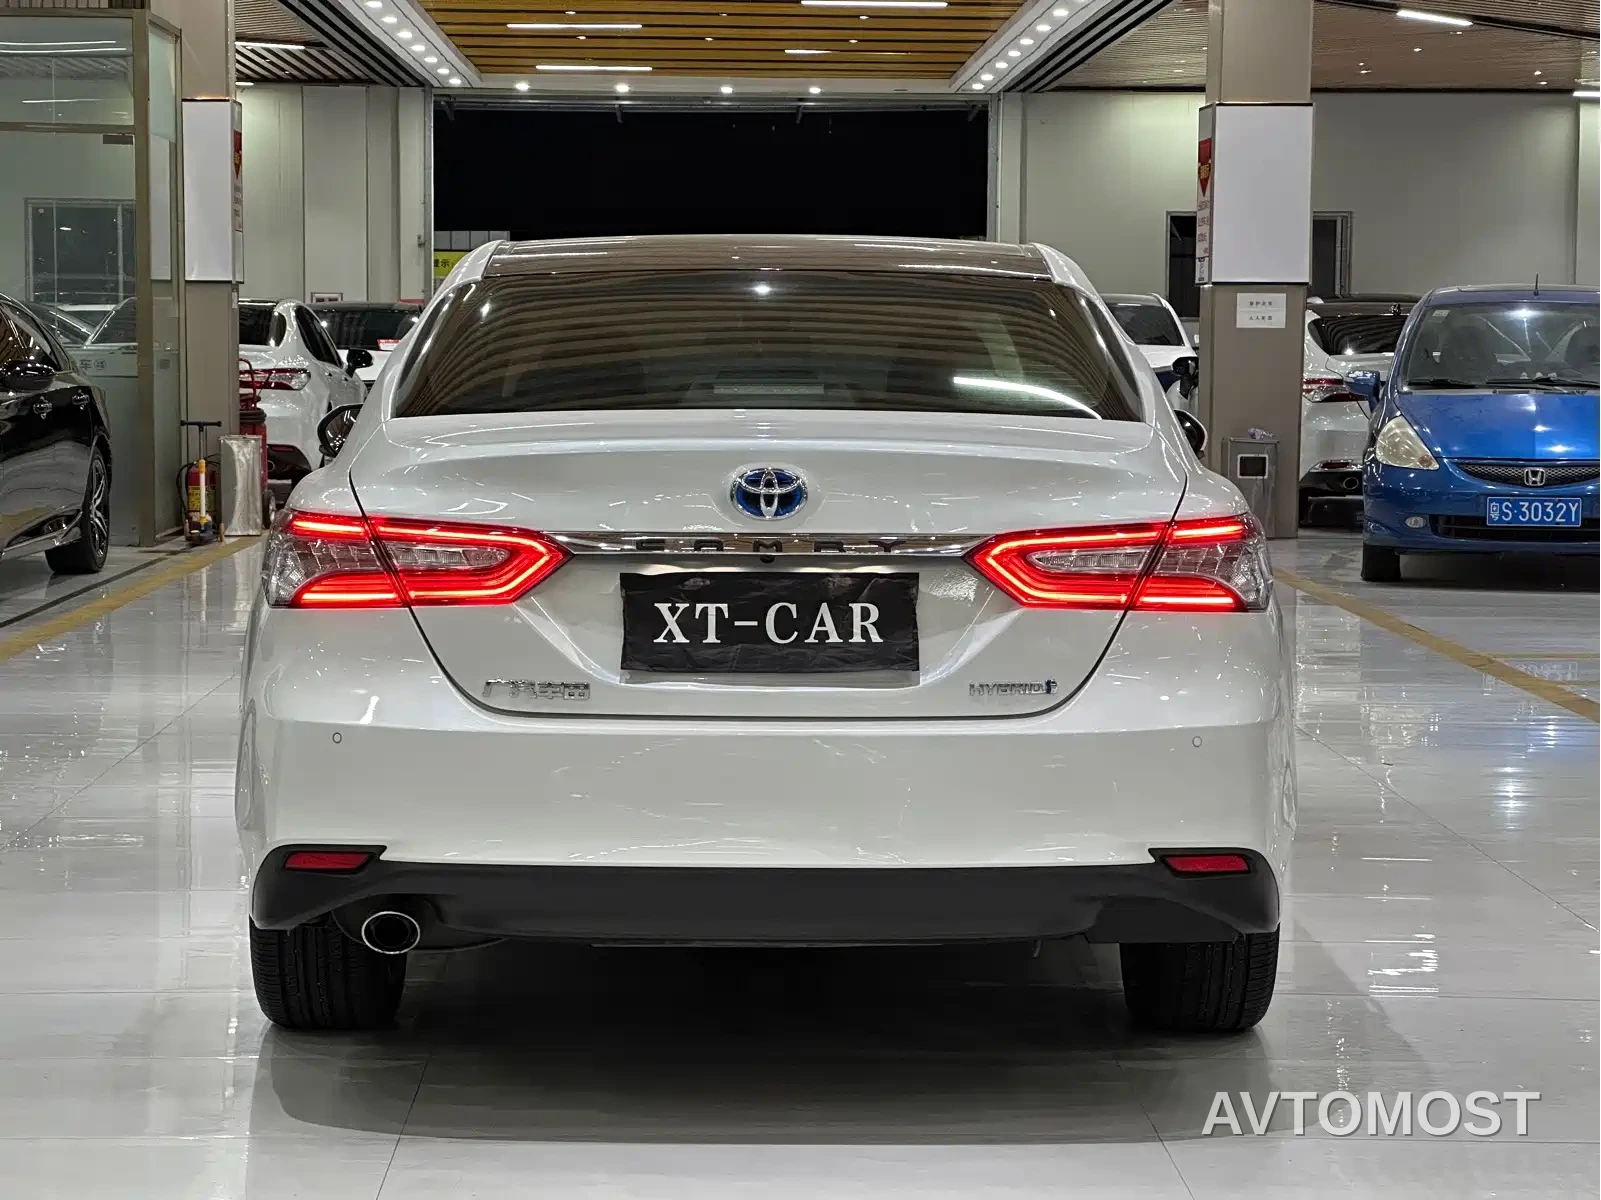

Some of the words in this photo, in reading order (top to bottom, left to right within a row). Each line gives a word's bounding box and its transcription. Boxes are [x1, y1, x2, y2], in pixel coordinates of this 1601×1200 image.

[635, 538, 907, 554] CAMRY
[652, 602, 884, 645] XT-CAR
[968, 681, 1044, 697] HYBRID
